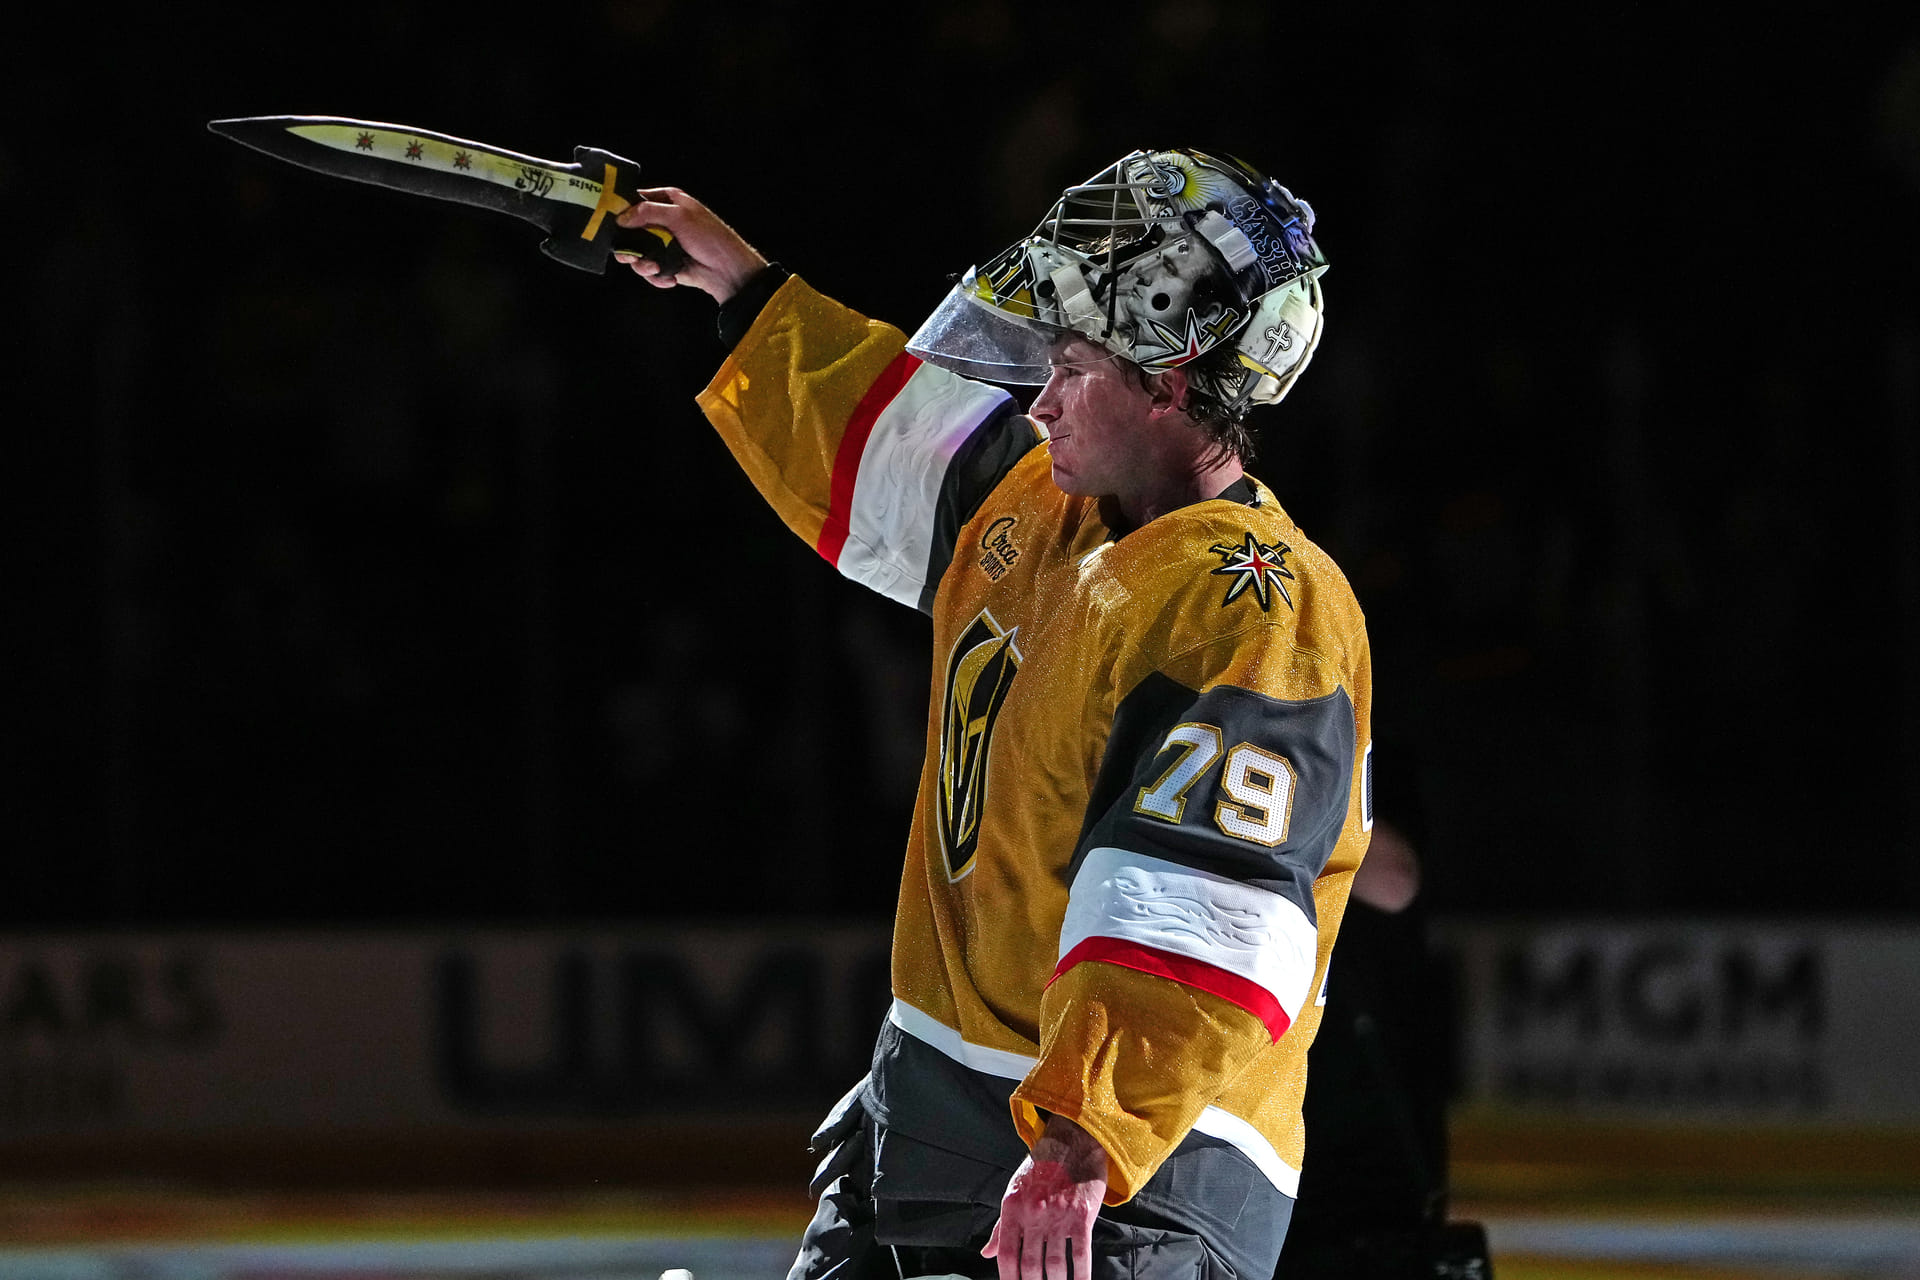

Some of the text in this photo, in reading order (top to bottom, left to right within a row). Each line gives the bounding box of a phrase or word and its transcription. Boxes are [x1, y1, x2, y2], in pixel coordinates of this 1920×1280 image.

[1228, 195, 1298, 284] CASH
[981, 516, 1019, 565] Circa
[1132, 721, 1298, 847] 79
[1503, 945, 1826, 1042] MGM
